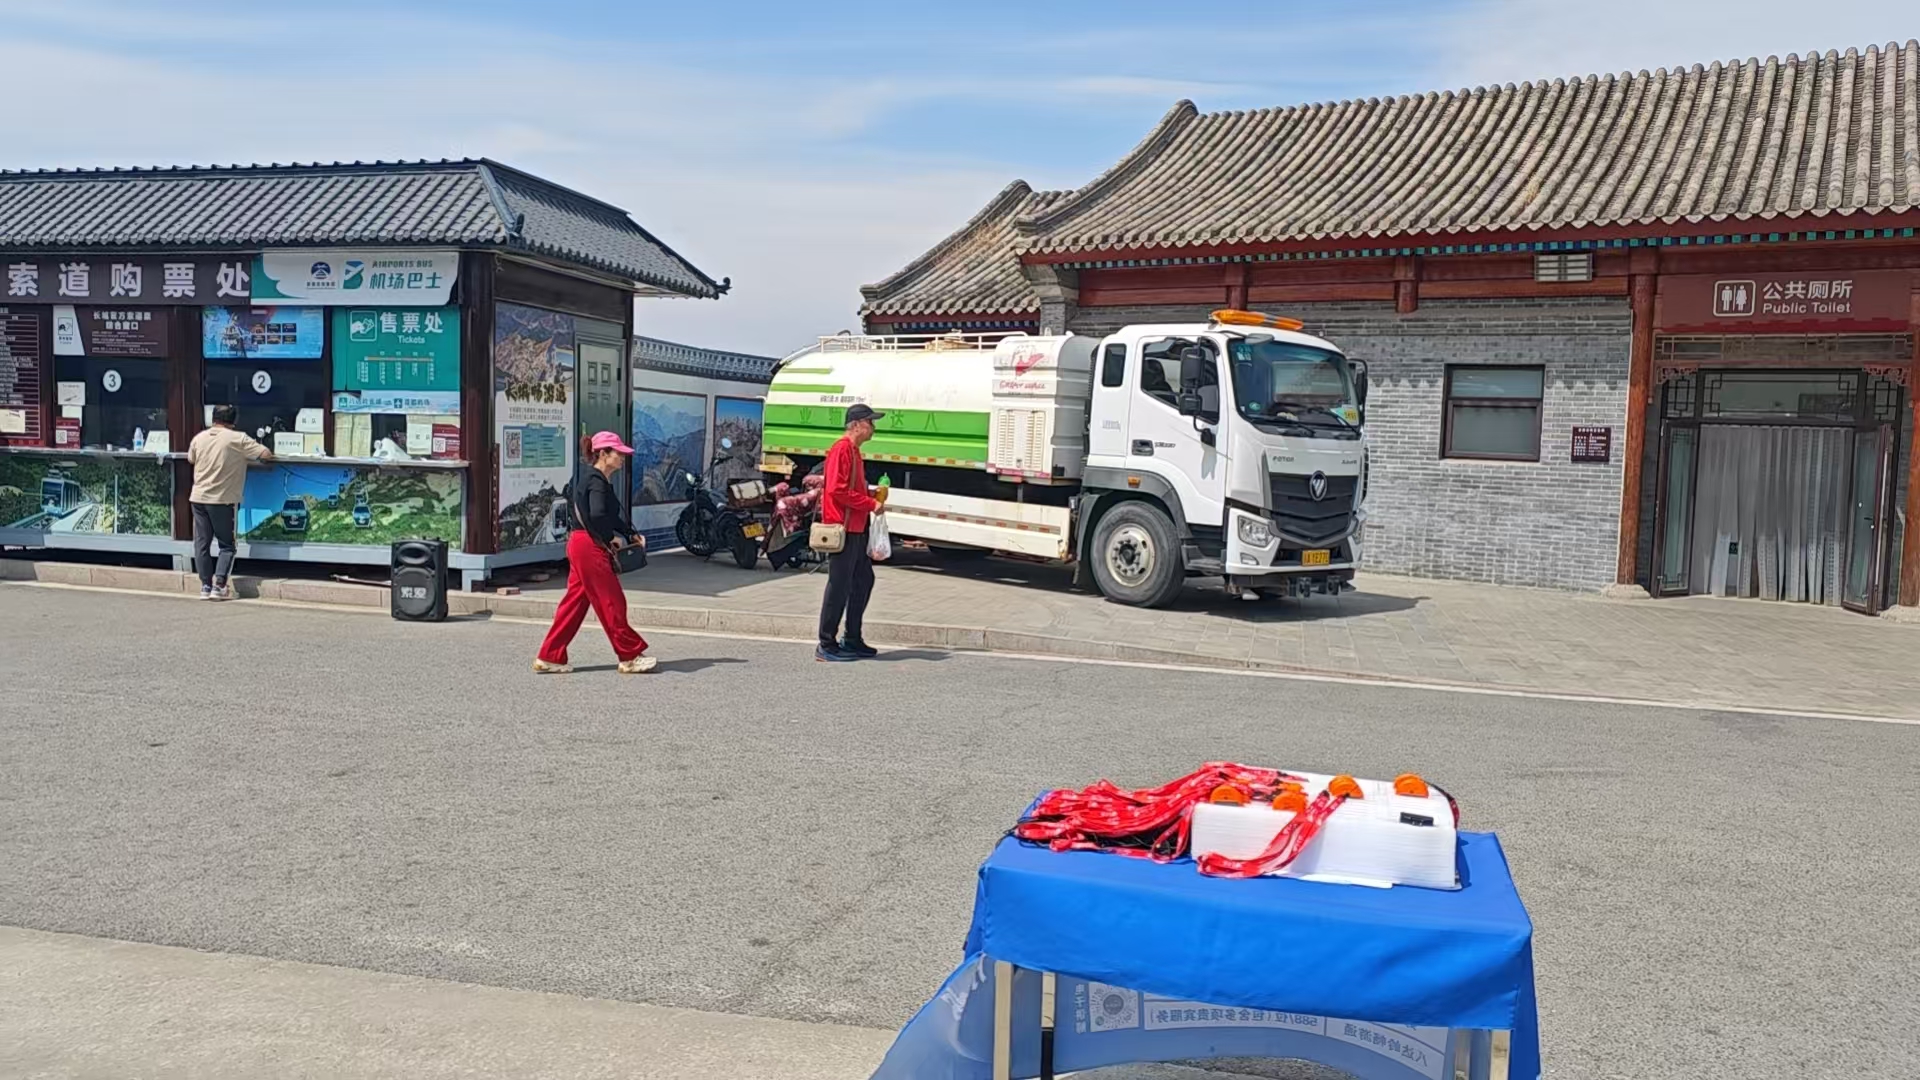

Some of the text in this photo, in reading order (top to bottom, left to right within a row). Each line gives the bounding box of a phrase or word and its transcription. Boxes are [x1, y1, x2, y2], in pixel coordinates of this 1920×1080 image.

[372, 260, 433, 269] AIRPORTS BUS
[8, 262, 249, 298] 索道购票处
[369, 272, 443, 290] 机场巴士
[1762, 280, 1853, 299] 公共厕所
[1763, 302, 1851, 314] Public Toilet
[380, 312, 443, 333] 售票处
[397, 335, 425, 344] Tickets
